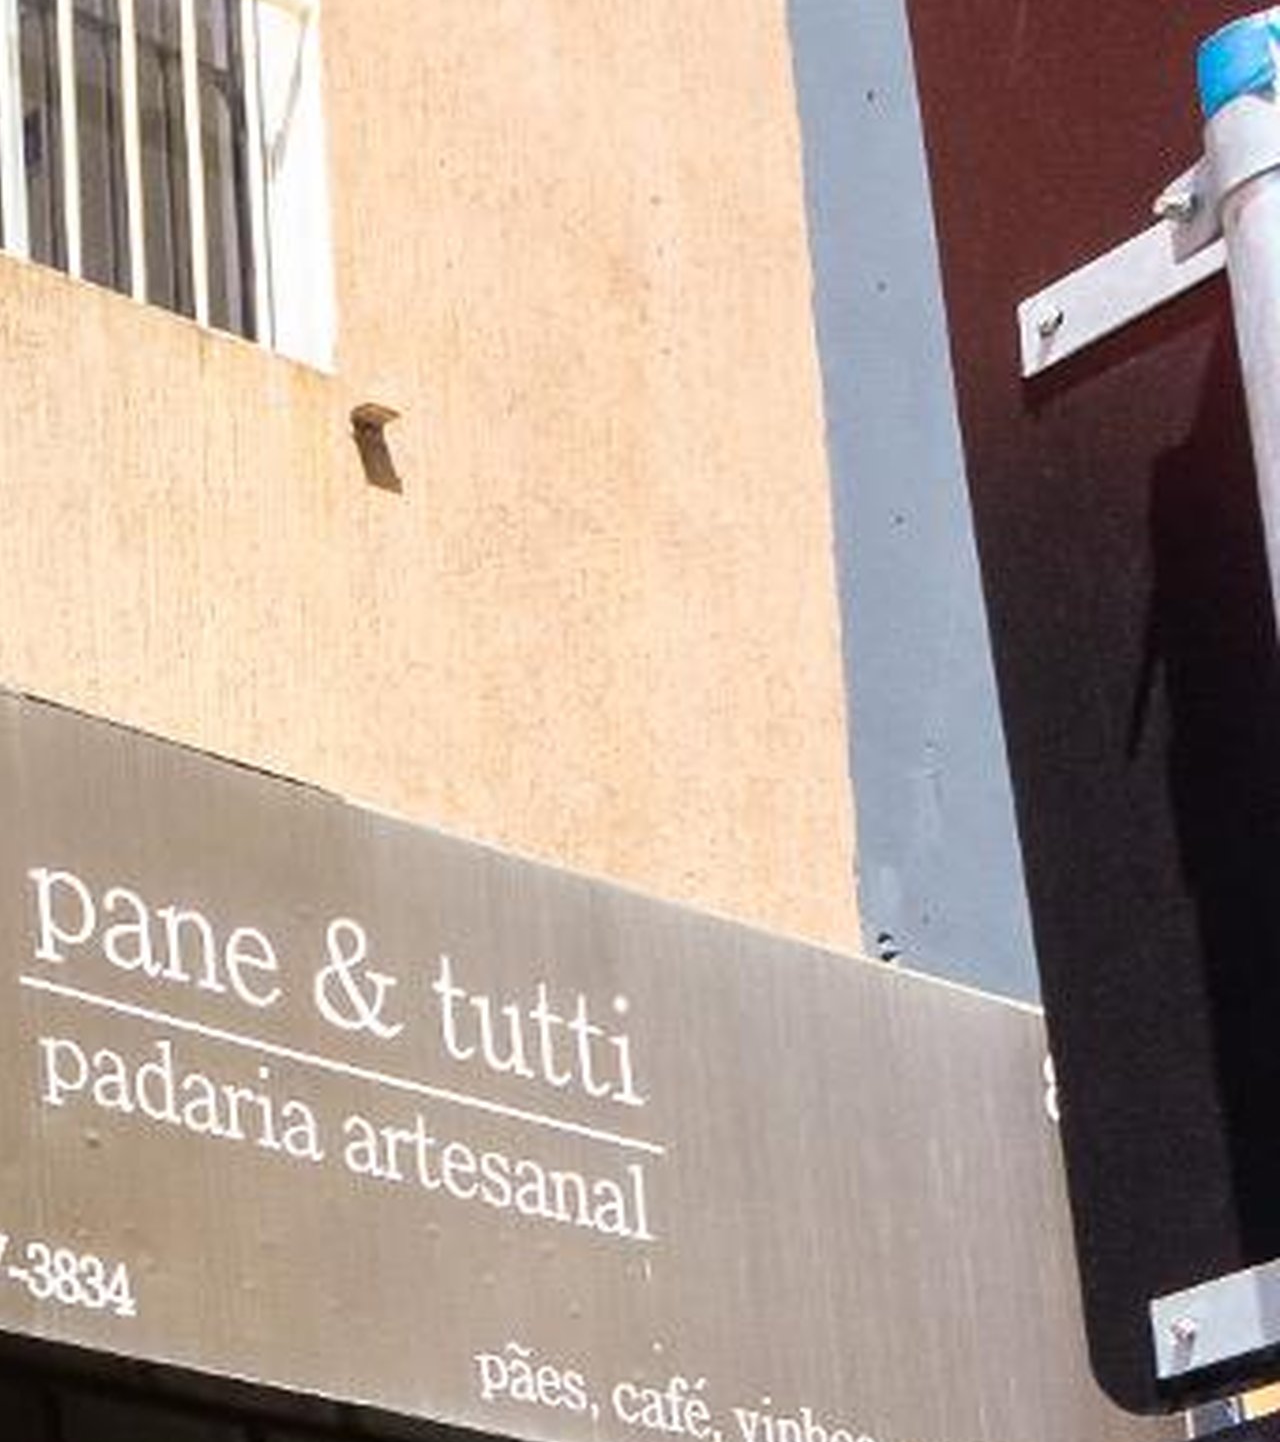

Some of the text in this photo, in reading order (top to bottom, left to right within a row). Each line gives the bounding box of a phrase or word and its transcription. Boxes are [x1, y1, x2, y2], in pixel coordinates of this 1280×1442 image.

[25, 866, 646, 1106] pane & tutti
[40, 1036, 655, 1241] padaria artesanal
[473, 1341, 600, 1418] pães,
